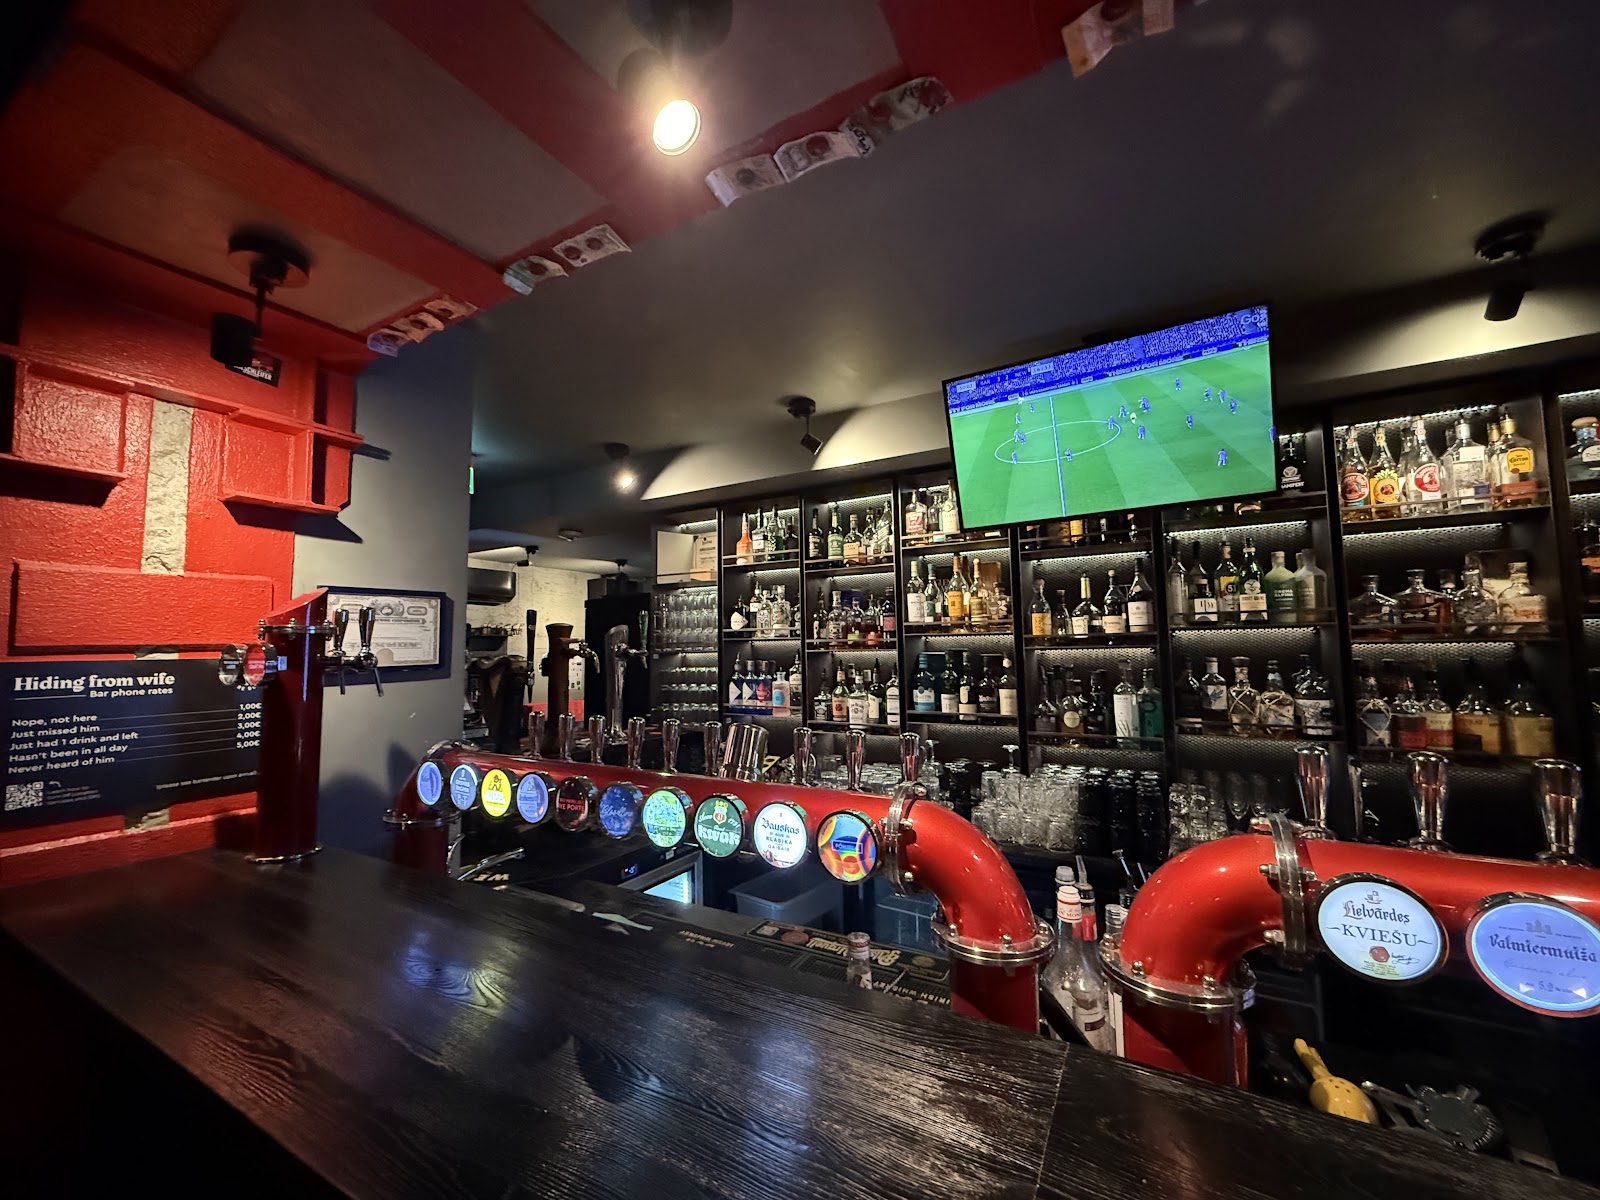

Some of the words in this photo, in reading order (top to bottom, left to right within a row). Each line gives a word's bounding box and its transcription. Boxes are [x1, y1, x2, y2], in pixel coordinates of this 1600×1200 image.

[1014, 370, 1028, 379] NEW
[14, 675, 86, 693] Hiding
[88, 674, 134, 688] from
[137, 672, 175, 686] wife
[89, 690, 109, 698] Bar
[111, 687, 146, 698] phone
[148, 687, 173, 695] rates
[11, 718, 48, 728] Nope,
[50, 715, 70, 724] not
[73, 714, 98, 722] here
[240, 702, 262, 711] 1,00€
[11, 730, 34, 739] Just
[38, 725, 77, 737] missed
[80, 724, 100, 733] him
[238, 712, 261, 721] 2,00€
[9, 742, 33, 751] Just
[36, 739, 59, 748] had
[61, 738, 67, 746] 1
[69, 735, 97, 746] drink
[100, 733, 120, 742] and
[122, 731, 139, 740] left
[237, 721, 261, 730] 3,00€
[9, 752, 47, 763] Hasn't
[50, 749, 79, 759] been
[82, 747, 91, 755] in
[94, 745, 106, 754] all
[109, 743, 128, 753] day
[236, 730, 260, 739] 4,00€
[8, 764, 43, 775] Never
[46, 759, 79, 770] heard
[82, 757, 94, 766] of
[96, 756, 115, 764] him
[236, 740, 260, 749] 5,00€
[761, 817, 801, 835] Bauskas
[765, 836, 793, 845] KLASIKA
[1343, 900, 1410, 925] Lielvārdes
[1341, 923, 1418, 947] KVIEŠU
[1489, 933, 1598, 963] Valmiermuiža
[920, 991, 951, 1005] IRISH
